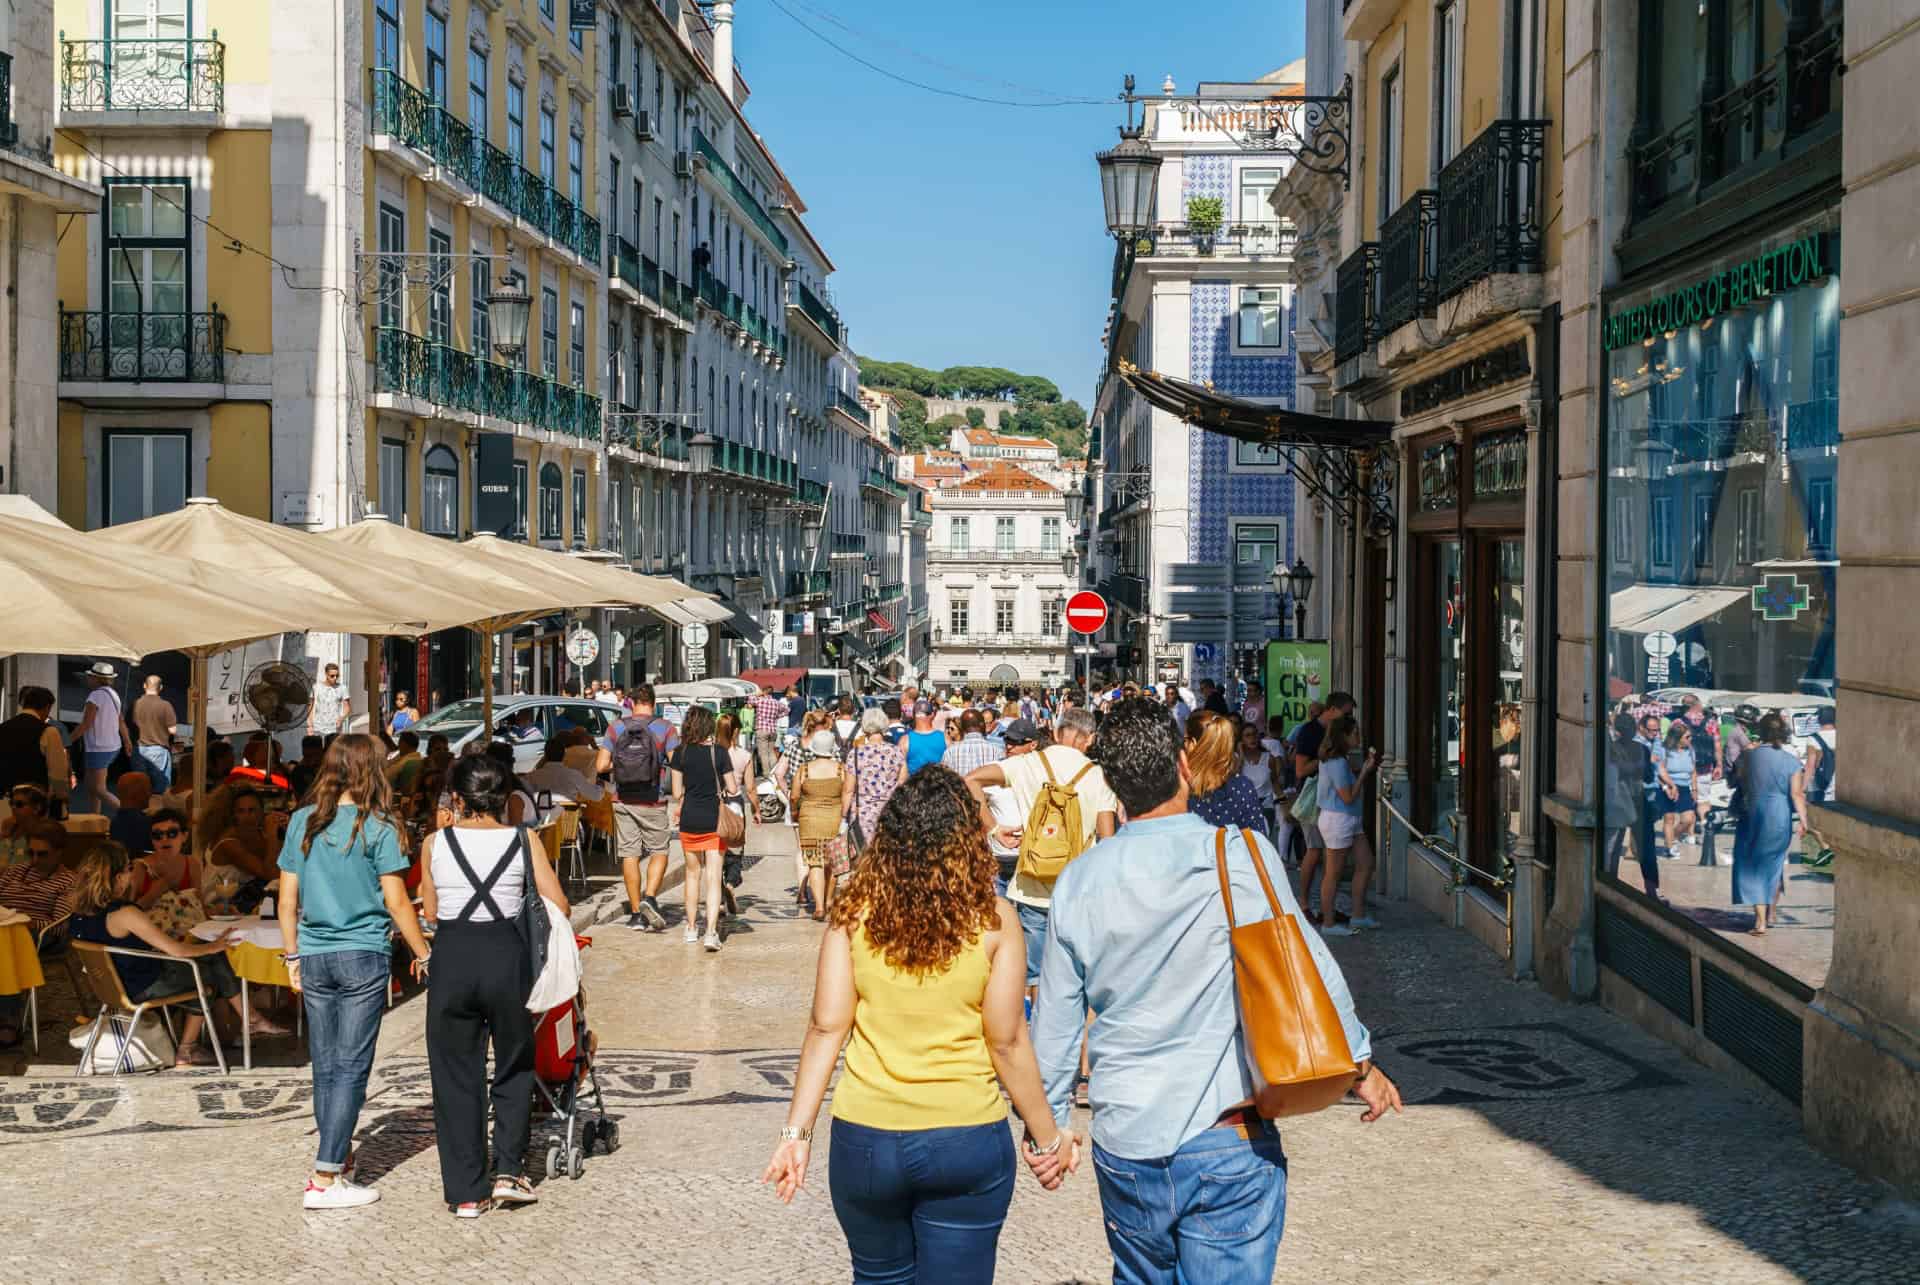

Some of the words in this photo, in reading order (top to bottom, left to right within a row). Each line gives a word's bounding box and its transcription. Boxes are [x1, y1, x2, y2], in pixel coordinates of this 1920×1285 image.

[1604, 304, 1647, 352] UNITED
[1649, 281, 1703, 336] COLORS
[1706, 272, 1727, 316] OF
[481, 485, 509, 493] GUESS
